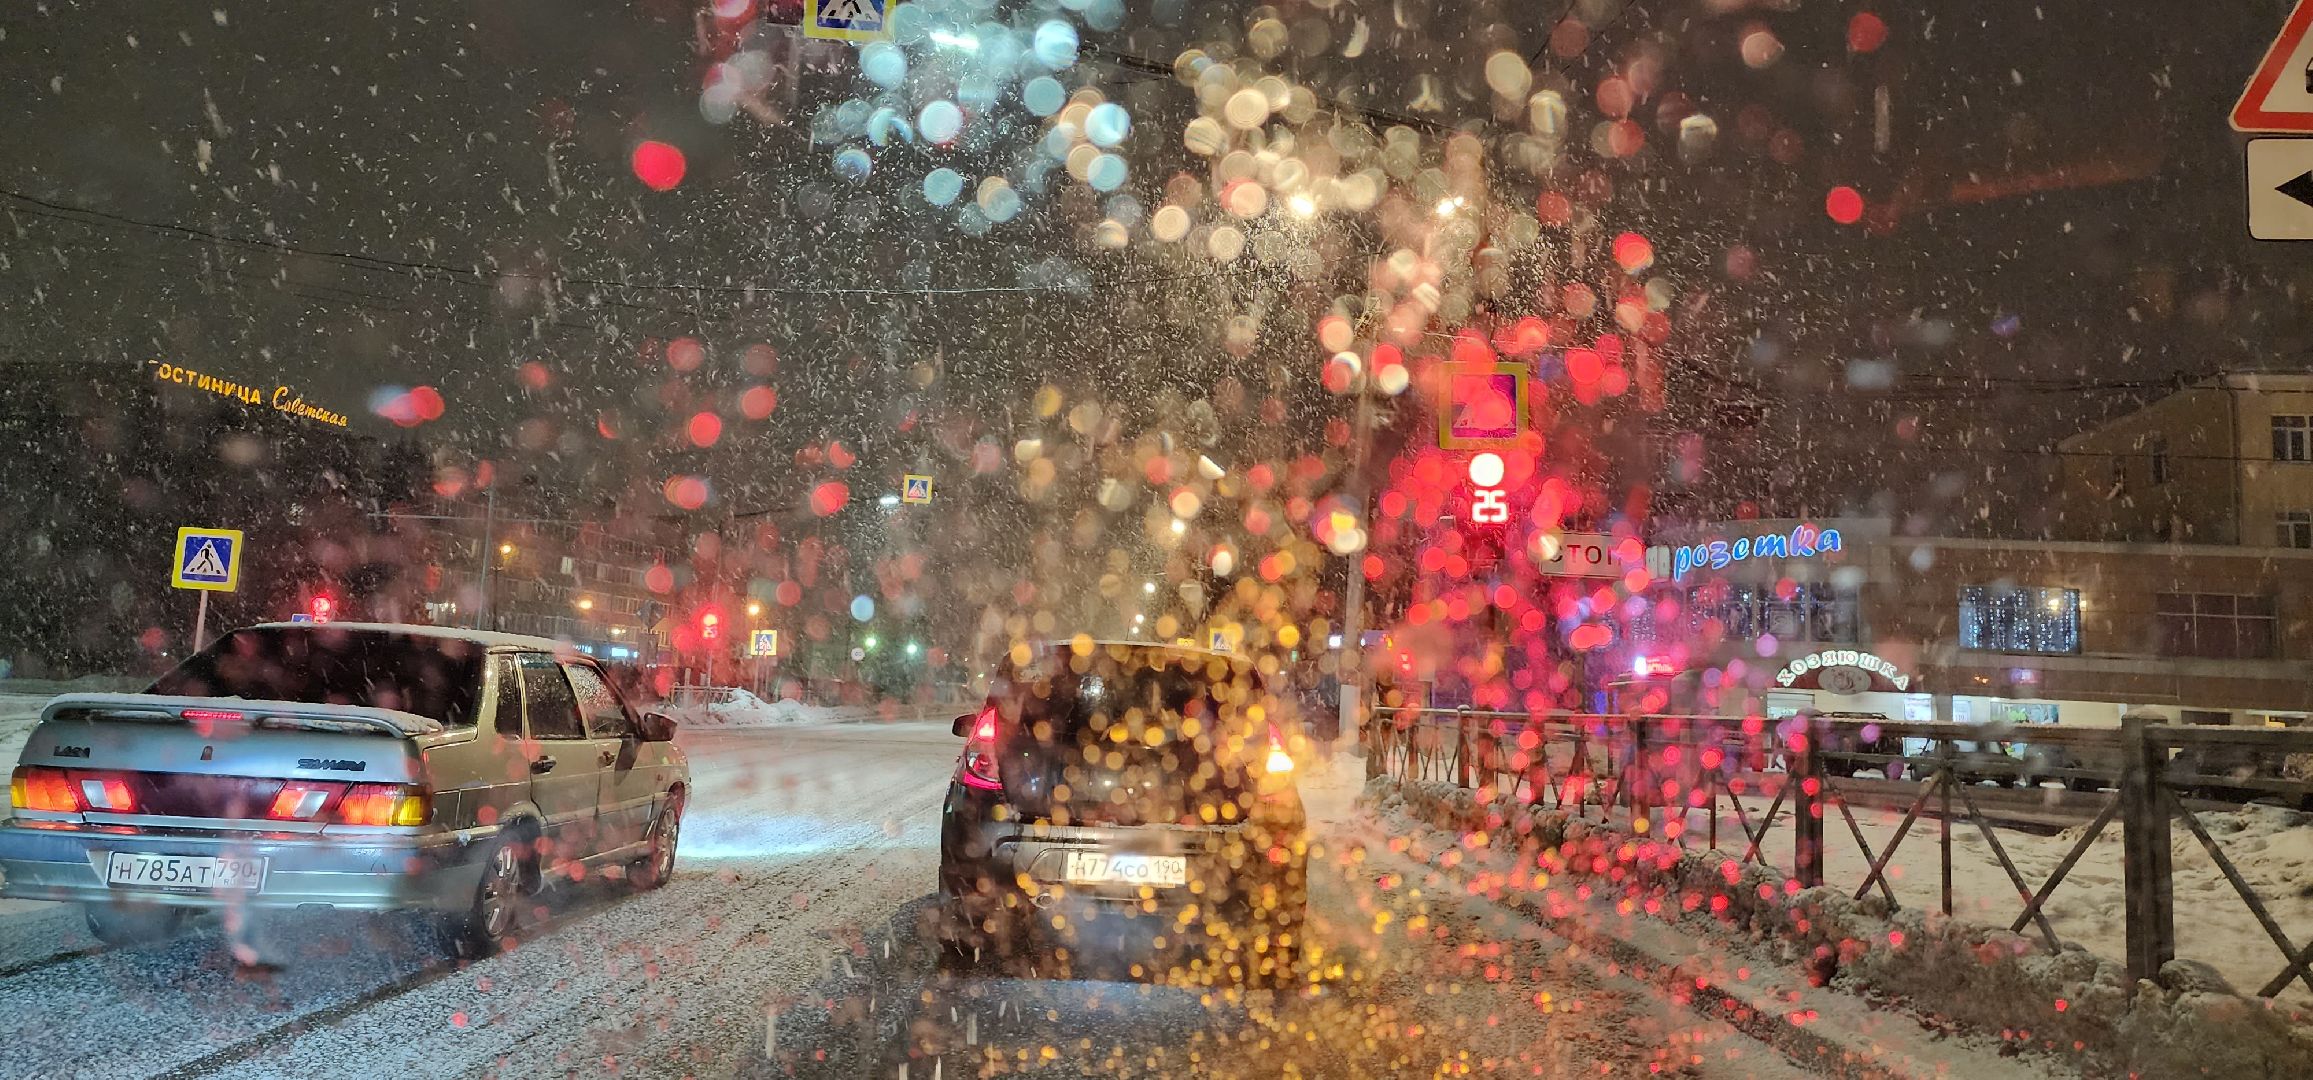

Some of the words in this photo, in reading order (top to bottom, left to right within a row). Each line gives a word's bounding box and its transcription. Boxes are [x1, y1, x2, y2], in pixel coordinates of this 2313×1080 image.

[149, 359, 262, 405] ОСТИНИЦА
[272, 386, 348, 427] Советская
[1472, 489, 1508, 522] 25
[1674, 525, 1842, 582] розетка
[1776, 650, 1909, 691] ХОЗЯЮШКА
[217, 860, 253, 878] 790
[1154, 860, 1181, 874] 190
